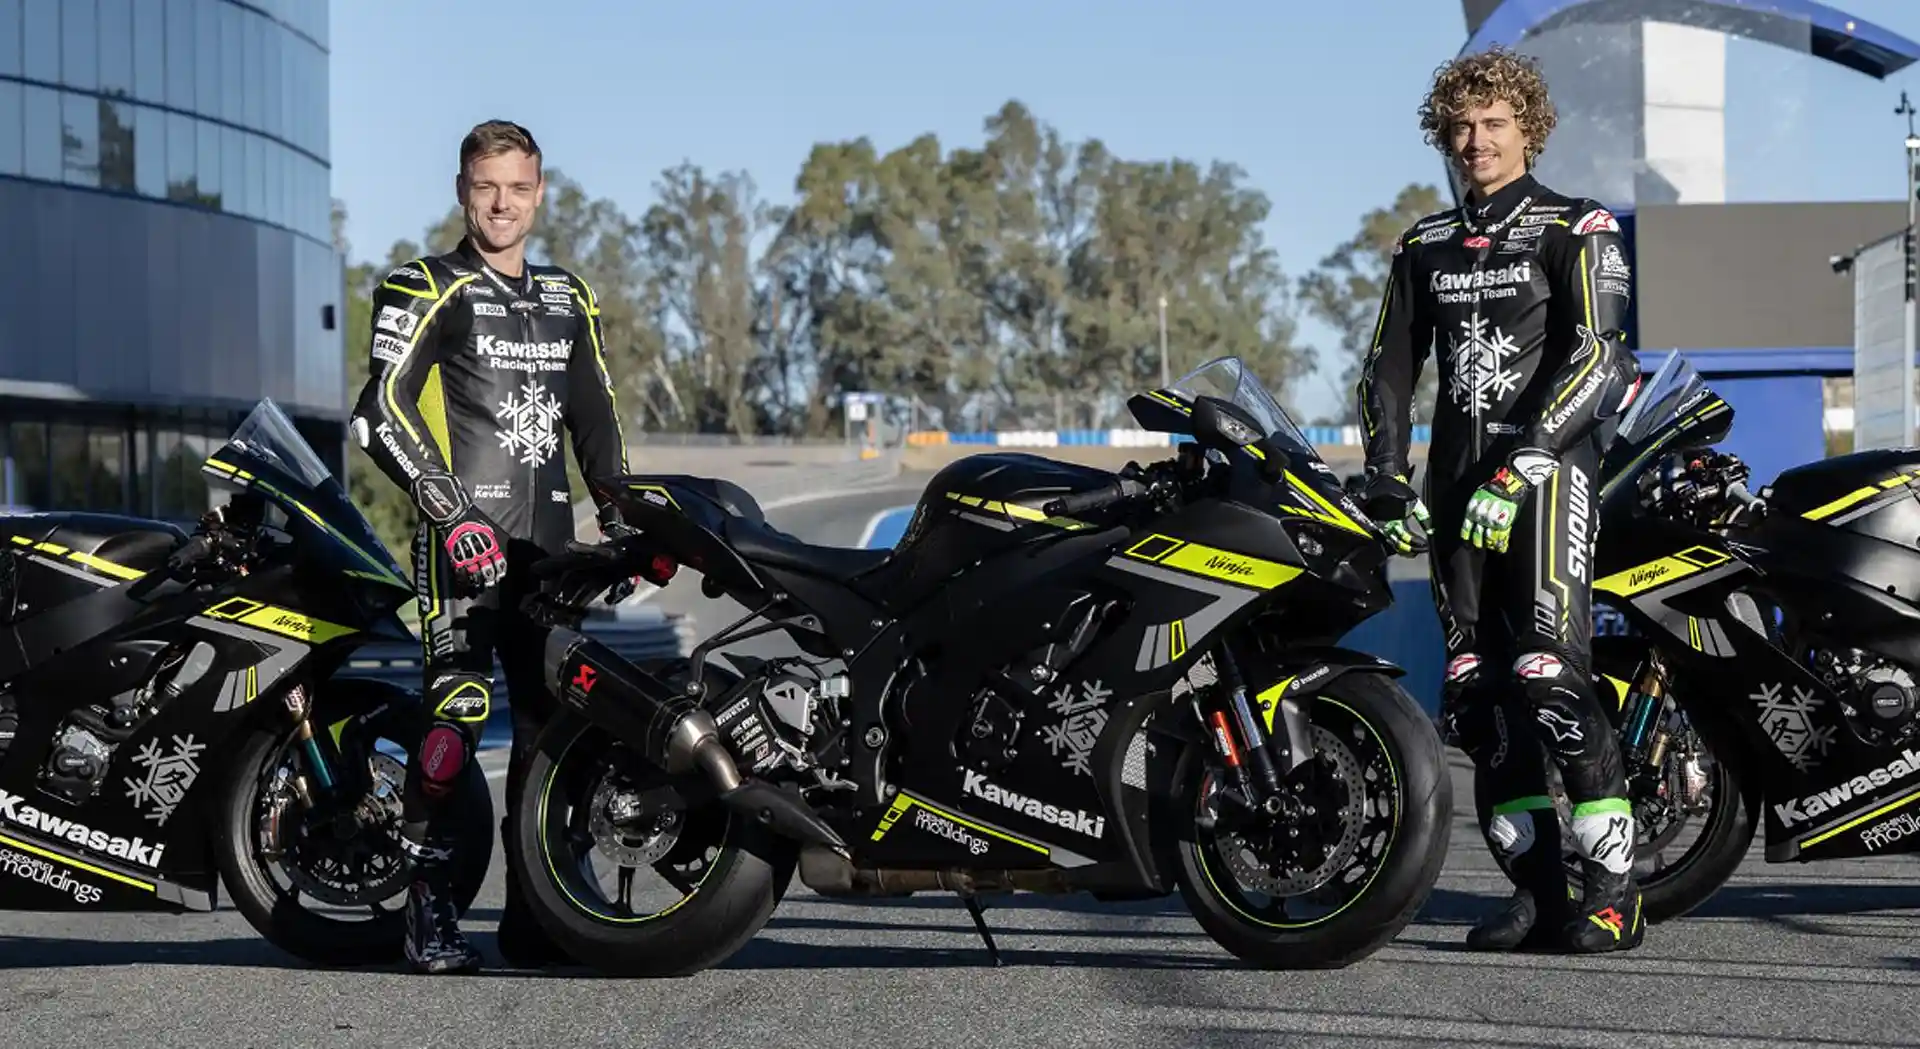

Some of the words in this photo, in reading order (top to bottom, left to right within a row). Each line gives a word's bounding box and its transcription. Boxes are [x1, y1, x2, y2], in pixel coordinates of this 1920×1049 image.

[1430, 262, 1531, 292] Kawasaki
[1438, 291, 1480, 305] Racing
[1482, 287, 1517, 300] Team
[490, 357, 536, 373] Racing
[536, 360, 566, 371] Team
[1542, 366, 1606, 433] Kawasaki
[1567, 464, 1590, 584] SHOWA
[1205, 555, 1254, 576] Ninja
[1628, 563, 1670, 588] Ninja
[272, 615, 317, 635] Ninja
[962, 768, 1105, 840] Kawasaki
[0, 788, 166, 869] Kawasaki
[914, 815, 990, 855] mouldings
